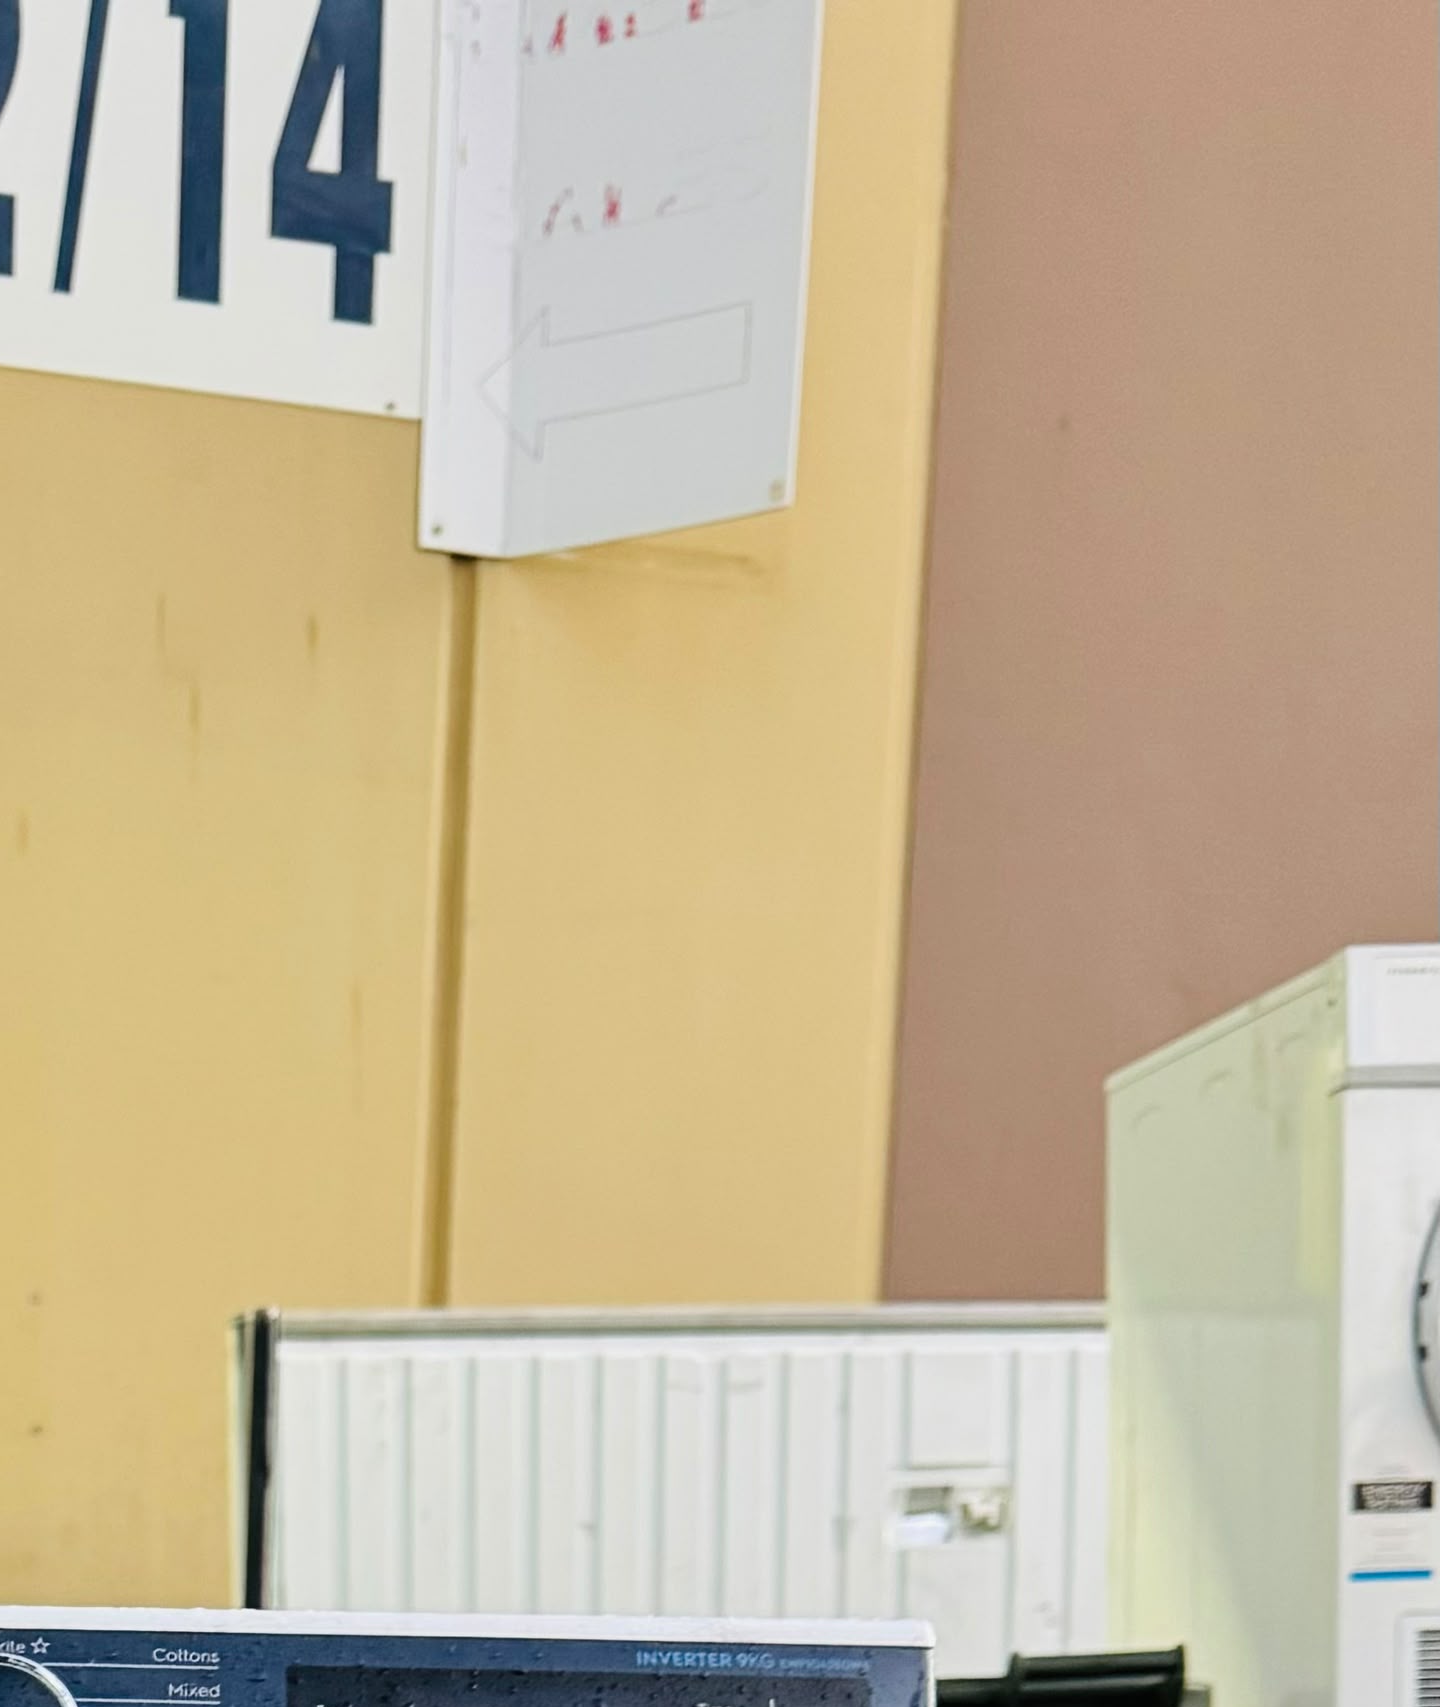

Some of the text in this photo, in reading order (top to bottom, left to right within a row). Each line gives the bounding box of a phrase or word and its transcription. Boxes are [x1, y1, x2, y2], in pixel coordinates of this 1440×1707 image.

[152, 1649, 220, 1663] Cottons
[636, 1652, 732, 1667] INVERTER
[168, 1684, 220, 1697] Mixed
